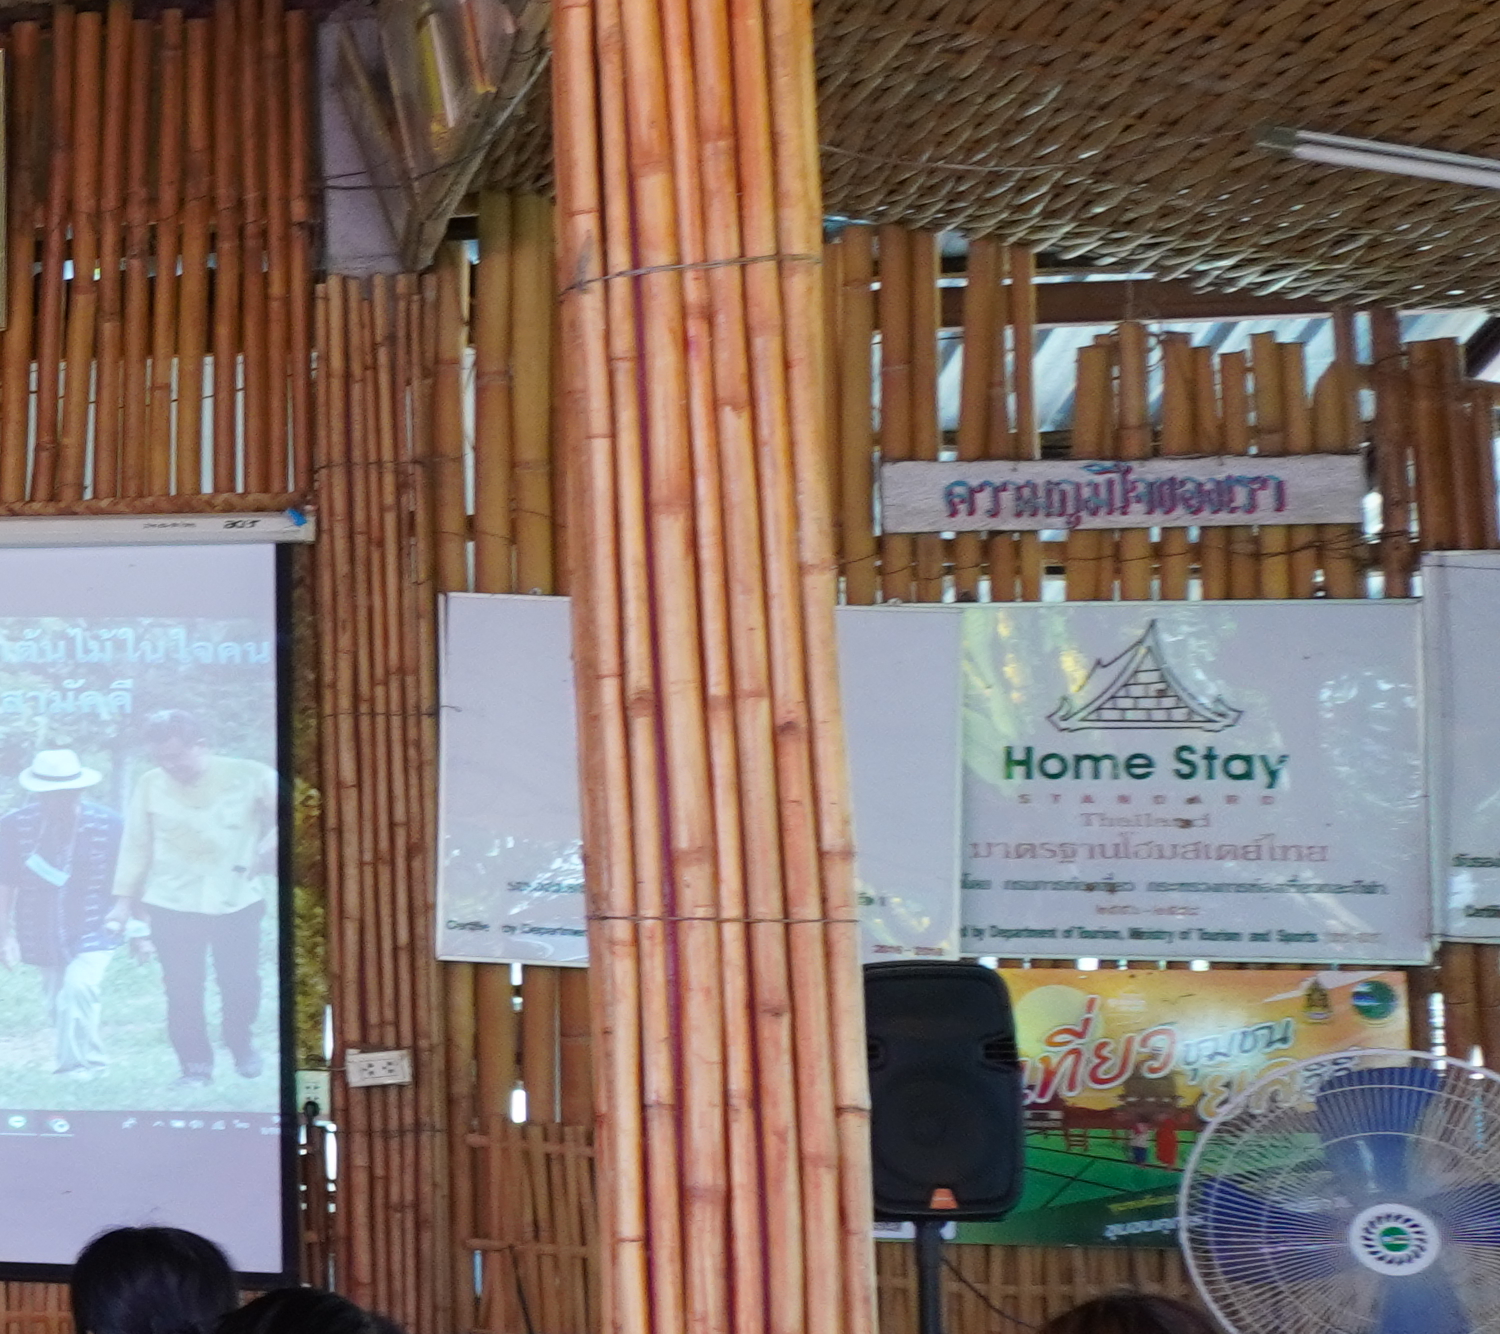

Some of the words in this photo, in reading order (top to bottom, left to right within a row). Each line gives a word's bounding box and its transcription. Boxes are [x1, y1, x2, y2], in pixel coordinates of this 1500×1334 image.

[1003, 745, 1155, 781] Home
[1173, 744, 1290, 789] Stay
[1017, 793, 1276, 805] STANDARD
[1080, 812, 1211, 828] Thailand
[969, 832, 1329, 863] มาตรฐานโฮมสเตย์ไทย
